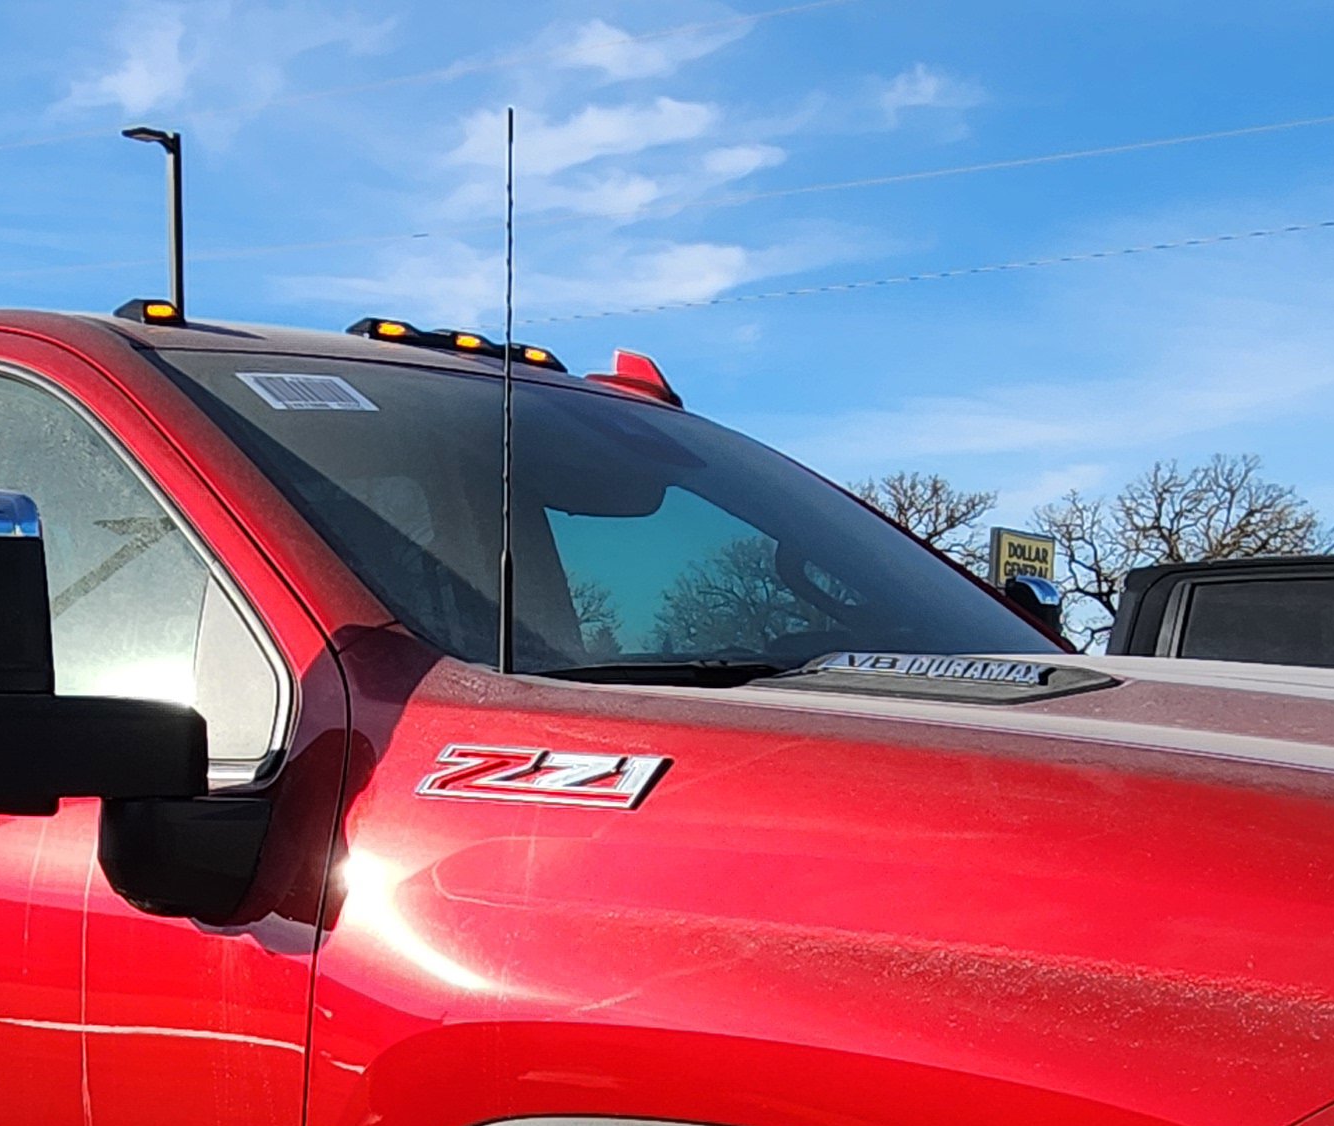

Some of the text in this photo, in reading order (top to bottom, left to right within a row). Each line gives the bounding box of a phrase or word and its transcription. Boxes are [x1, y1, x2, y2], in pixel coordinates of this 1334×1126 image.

[1008, 541, 1049, 565] DOLLAR
[847, 652, 1041, 684] V8 DURAMAX
[415, 743, 674, 812] Z71
